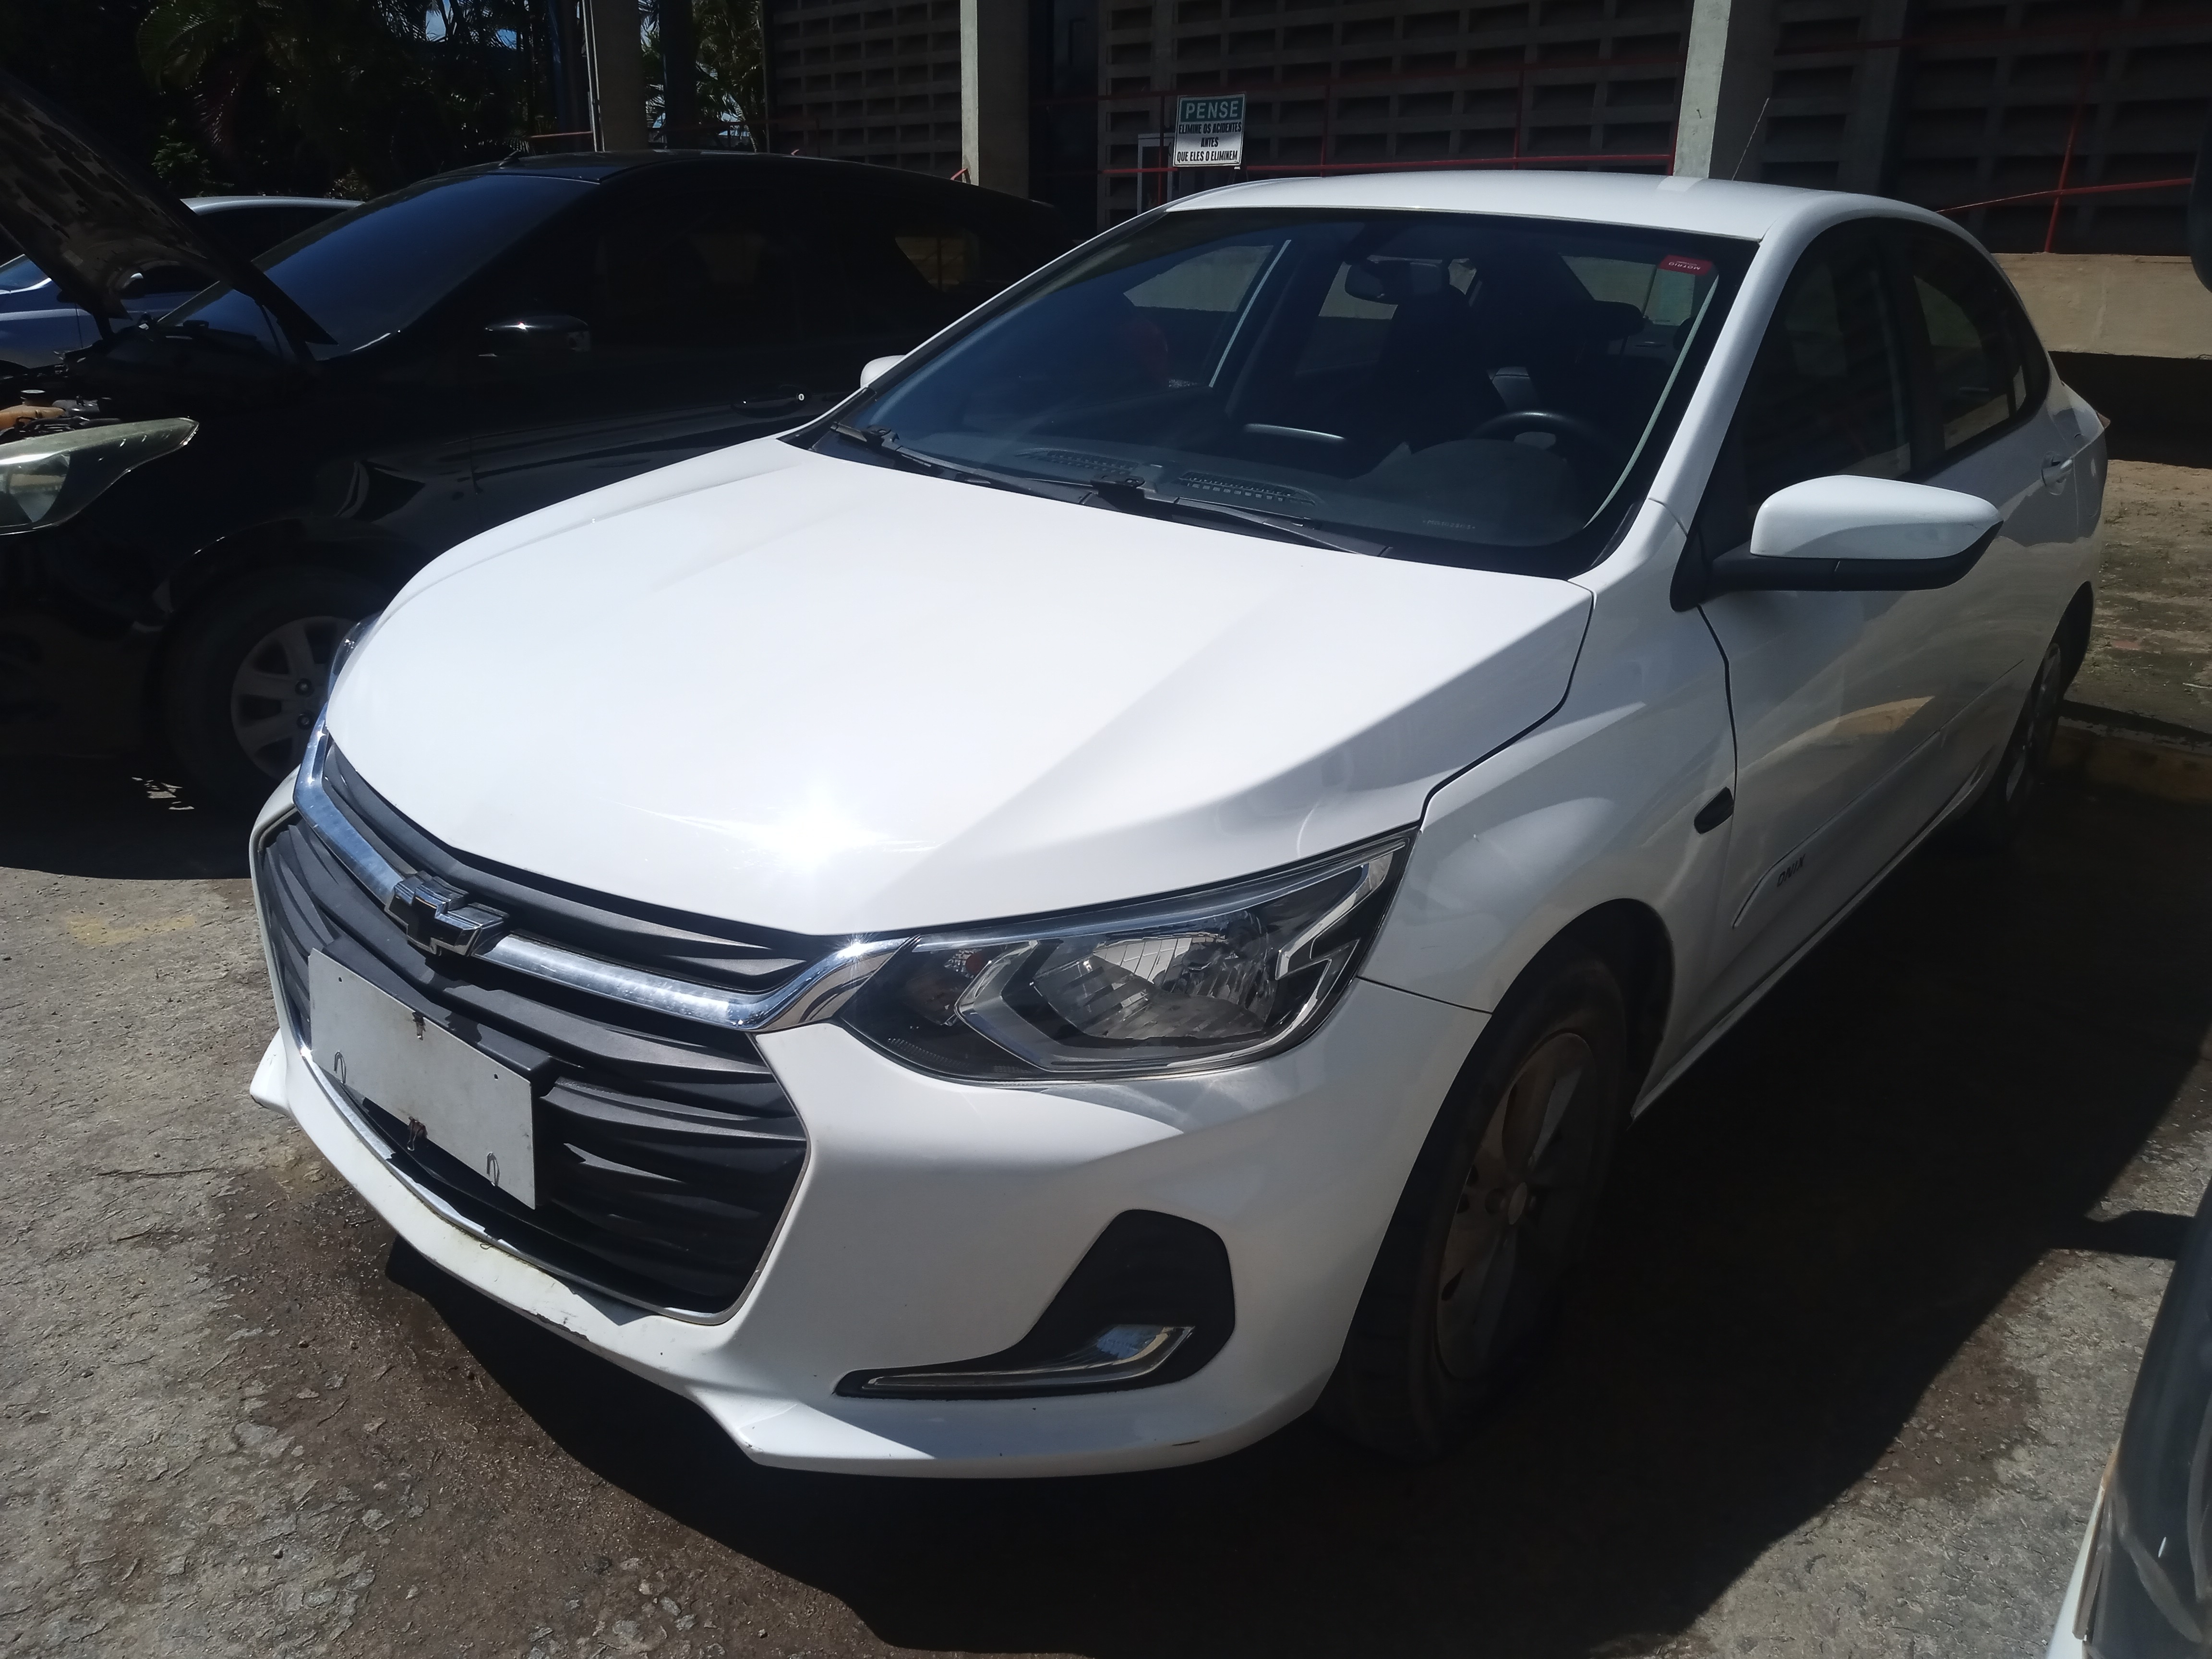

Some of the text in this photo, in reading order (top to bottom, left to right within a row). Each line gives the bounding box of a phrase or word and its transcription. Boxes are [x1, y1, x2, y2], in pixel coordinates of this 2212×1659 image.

[1185, 100, 1239, 119] PENSE
[1178, 121, 1242, 134] ELIMINE OS ACIDENTES
[1201, 136, 1219, 148] ANTES
[1177, 150, 1238, 163] QUE ELES O ELIMINEM
[1668, 262, 1701, 271] MOTRIO
